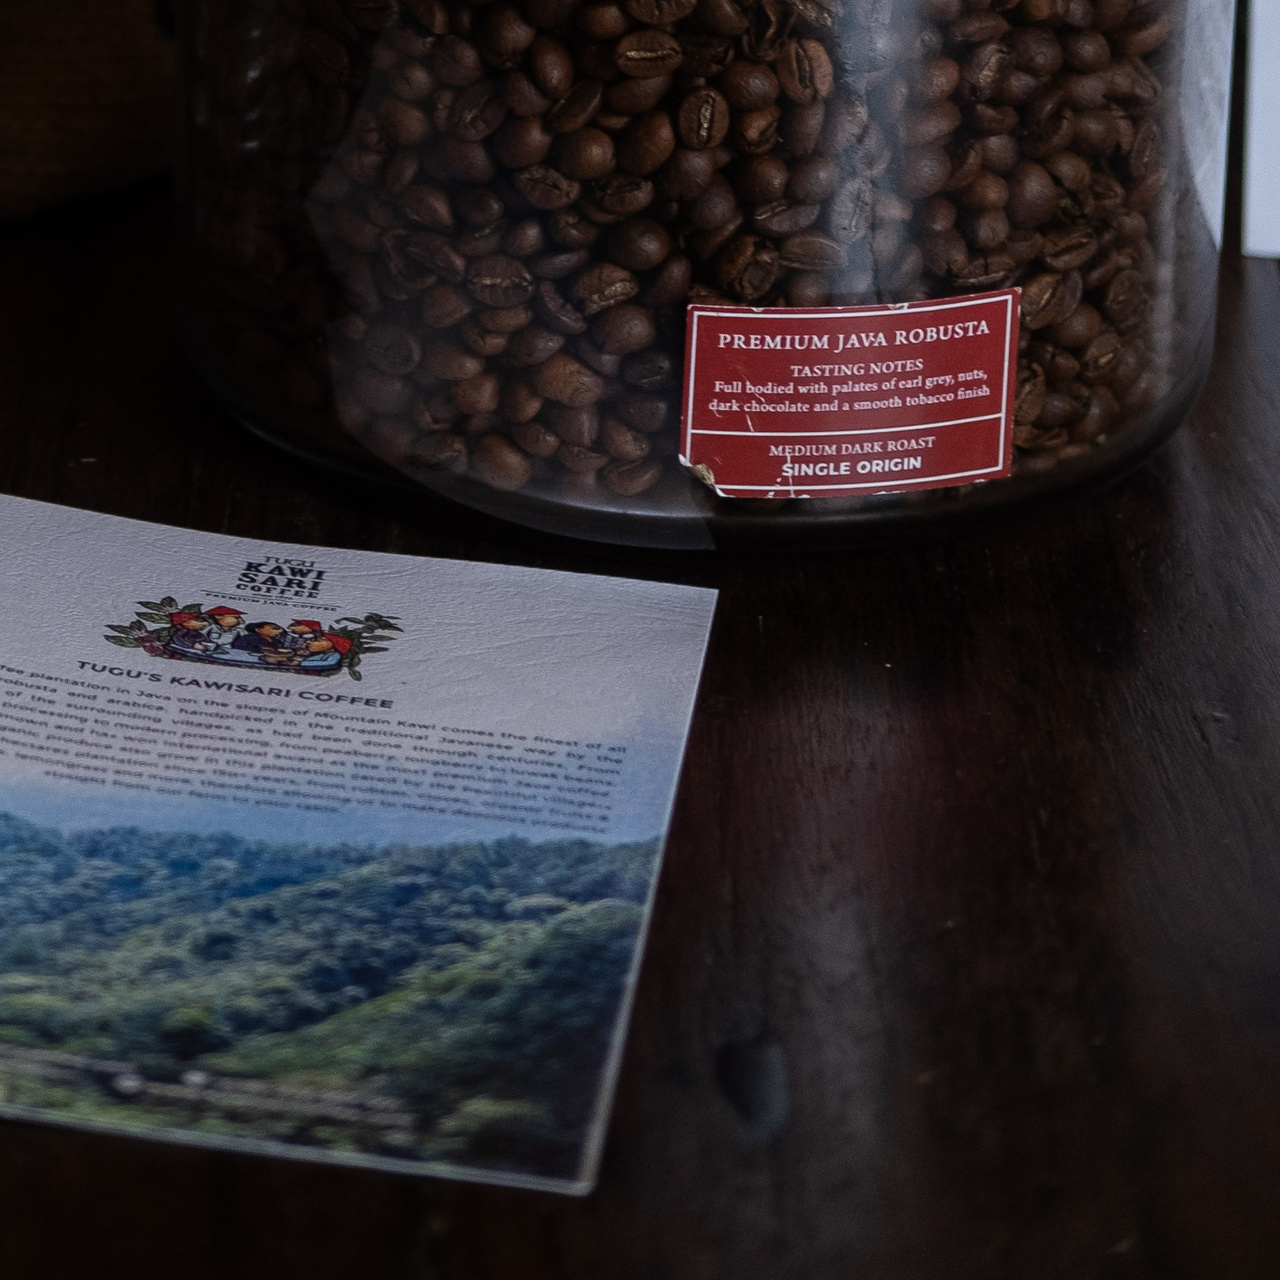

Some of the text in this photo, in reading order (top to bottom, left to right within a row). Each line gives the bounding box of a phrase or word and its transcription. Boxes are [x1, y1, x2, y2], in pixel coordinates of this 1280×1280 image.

[718, 320, 991, 353] PREMIUM JAVA ROBUSTA
[790, 358, 924, 378] TASTING NOTES
[714, 369, 988, 397] Full bodied with palates of earl grey, nuts,
[709, 385, 990, 413] dark chocolate and a smooth tobacco finish
[769, 436, 936, 457] MEDIUM DARK ROAST
[781, 456, 922, 477] SINGLE ORIGIN
[243, 561, 326, 581] KAWI
[263, 556, 316, 568] TUGU
[235, 583, 320, 599] COFFEE
[238, 572, 322, 591] SARI
[77, 660, 394, 709] TUGU'S KAWISARI COFFEE
[29, 672, 111, 692] plantation
[116, 687, 131, 695] in
[136, 690, 172, 701] Java
[176, 697, 198, 705] on
[204, 699, 229, 708] the
[236, 704, 286, 715] slopes
[314, 711, 391, 726] Mountain
[397, 720, 436, 730] Kawi
[441, 726, 495, 737] comes
[500, 732, 527, 741] the
[533, 735, 579, 747] finest
[607, 746, 627, 754] all
[67, 691, 98, 701] and
[178, 707, 274, 724] handpicked
[307, 722, 334, 731] the
[344, 726, 429, 741] traditional
[439, 736, 513, 751] Javanese
[523, 747, 556, 757] way
[565, 751, 586, 761] by
[596, 755, 624, 765] the
